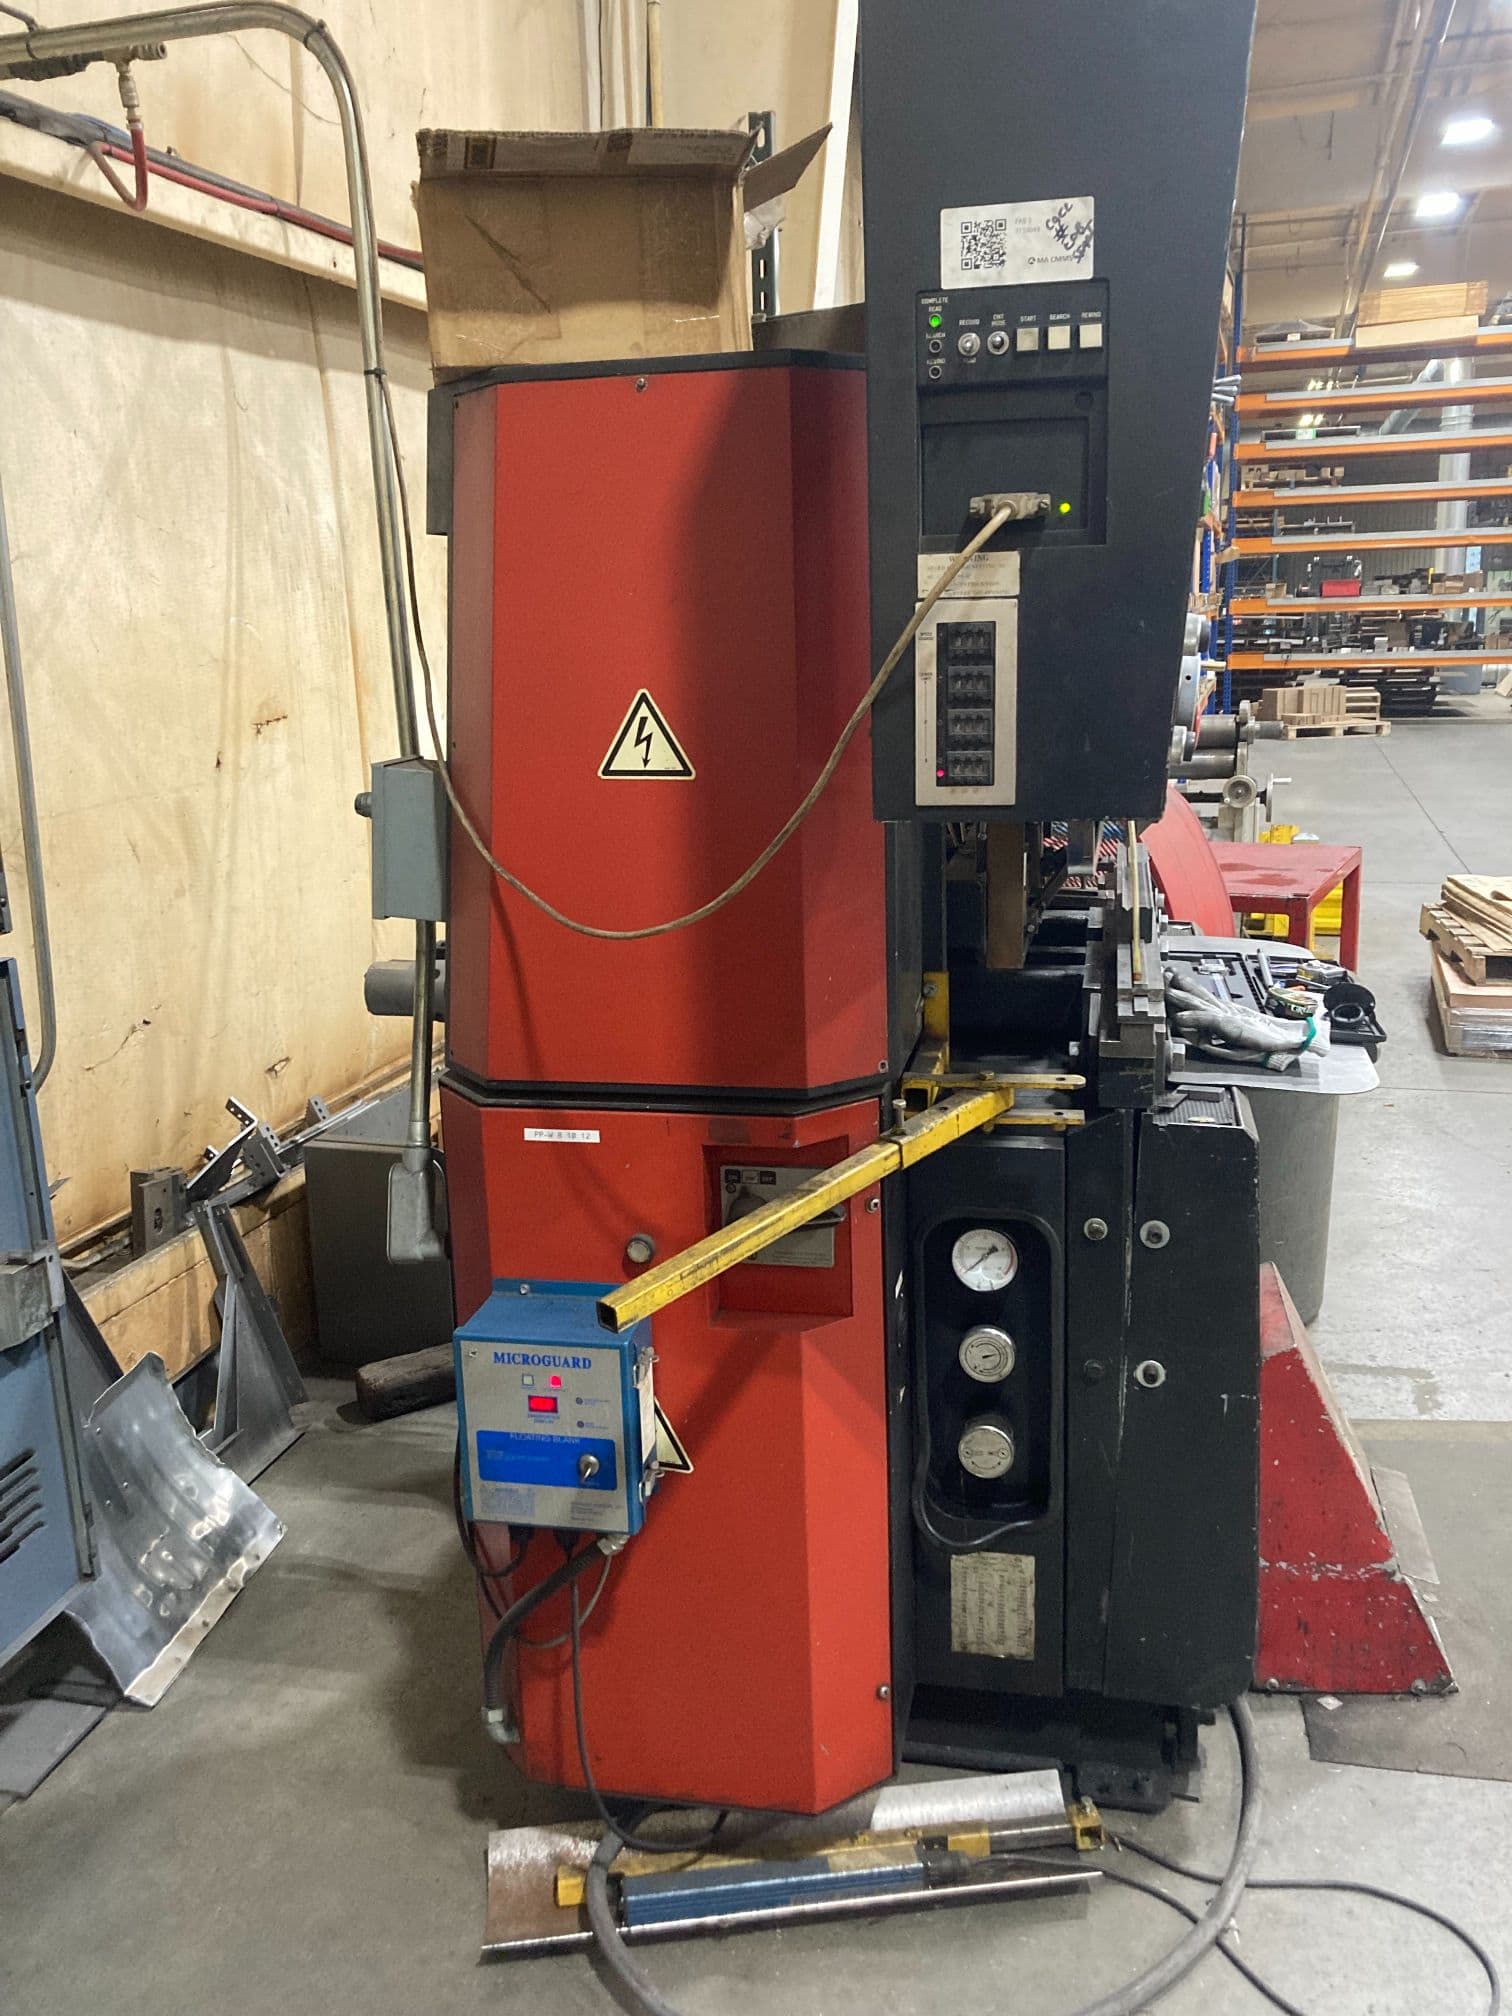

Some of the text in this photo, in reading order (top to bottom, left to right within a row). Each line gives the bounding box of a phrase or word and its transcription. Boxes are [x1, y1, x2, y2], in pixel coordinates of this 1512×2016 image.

[921, 296, 949, 305] COMPLETE
[1049, 313, 1071, 321] SEARCH
[1081, 311, 1102, 319] REWIND
[493, 1351, 592, 1370] MICROGUARD
[510, 1431, 551, 1443] FLOATING
